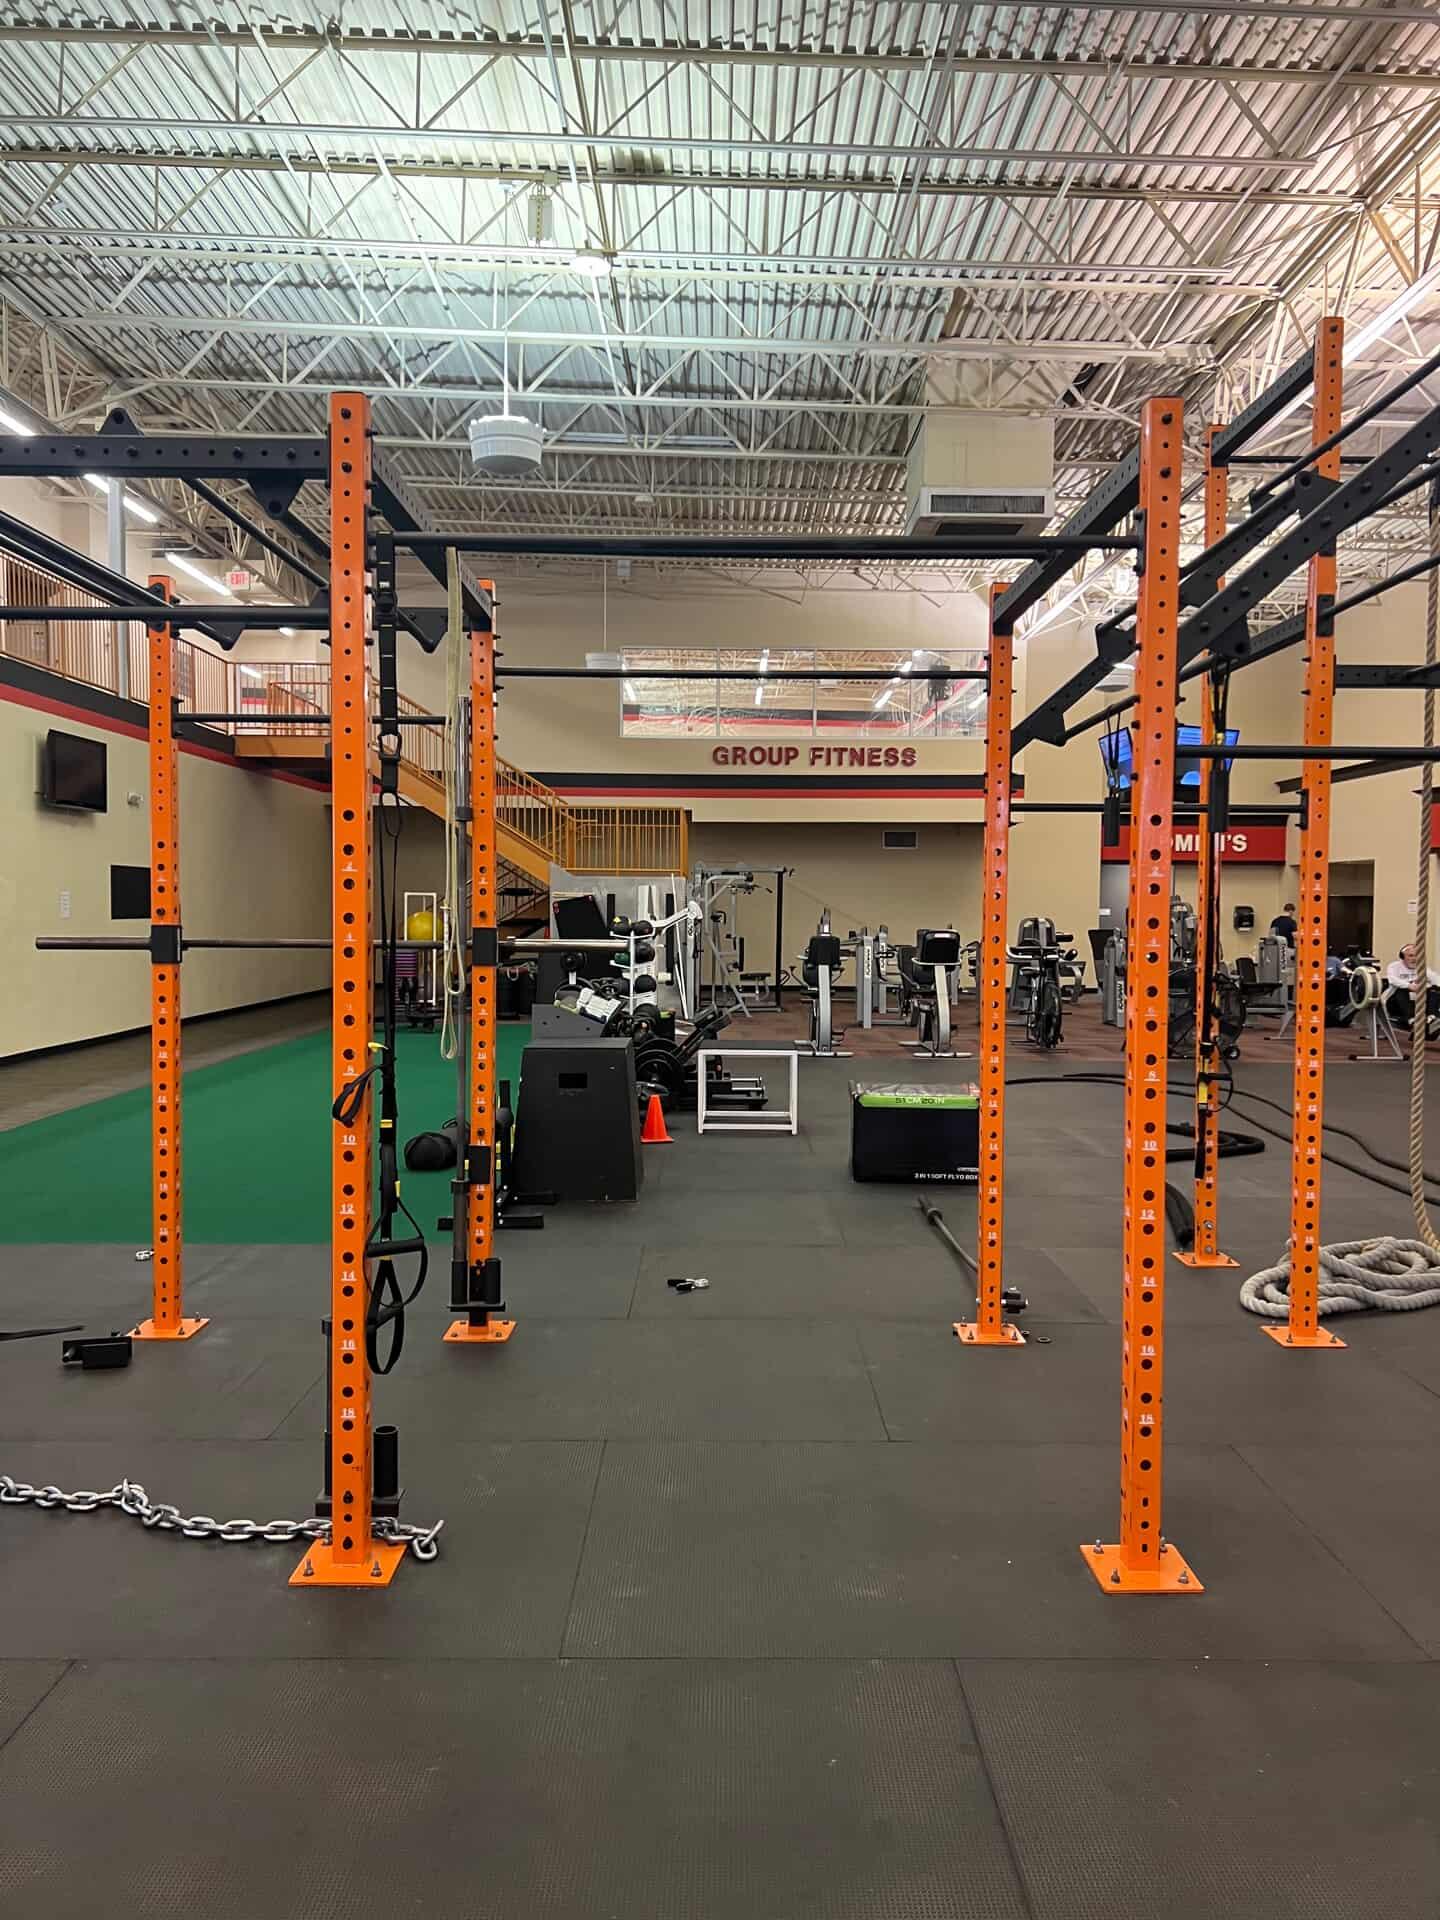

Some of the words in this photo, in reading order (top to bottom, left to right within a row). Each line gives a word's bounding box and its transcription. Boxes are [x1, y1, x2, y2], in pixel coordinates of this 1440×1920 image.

[712, 745, 800, 767] GROUP
[808, 746, 918, 768] FITNESS
[342, 1134, 357, 1145] 10
[1143, 1140, 1157, 1151] 10
[341, 1203, 355, 1215] 12
[1141, 1209, 1155, 1220] 12
[341, 1271, 356, 1281] 14
[1142, 1276, 1157, 1287] 14
[341, 1339, 356, 1350] 16
[1140, 1345, 1156, 1356] 16
[342, 1407, 356, 1418] 18
[1140, 1414, 1154, 1425] 18
